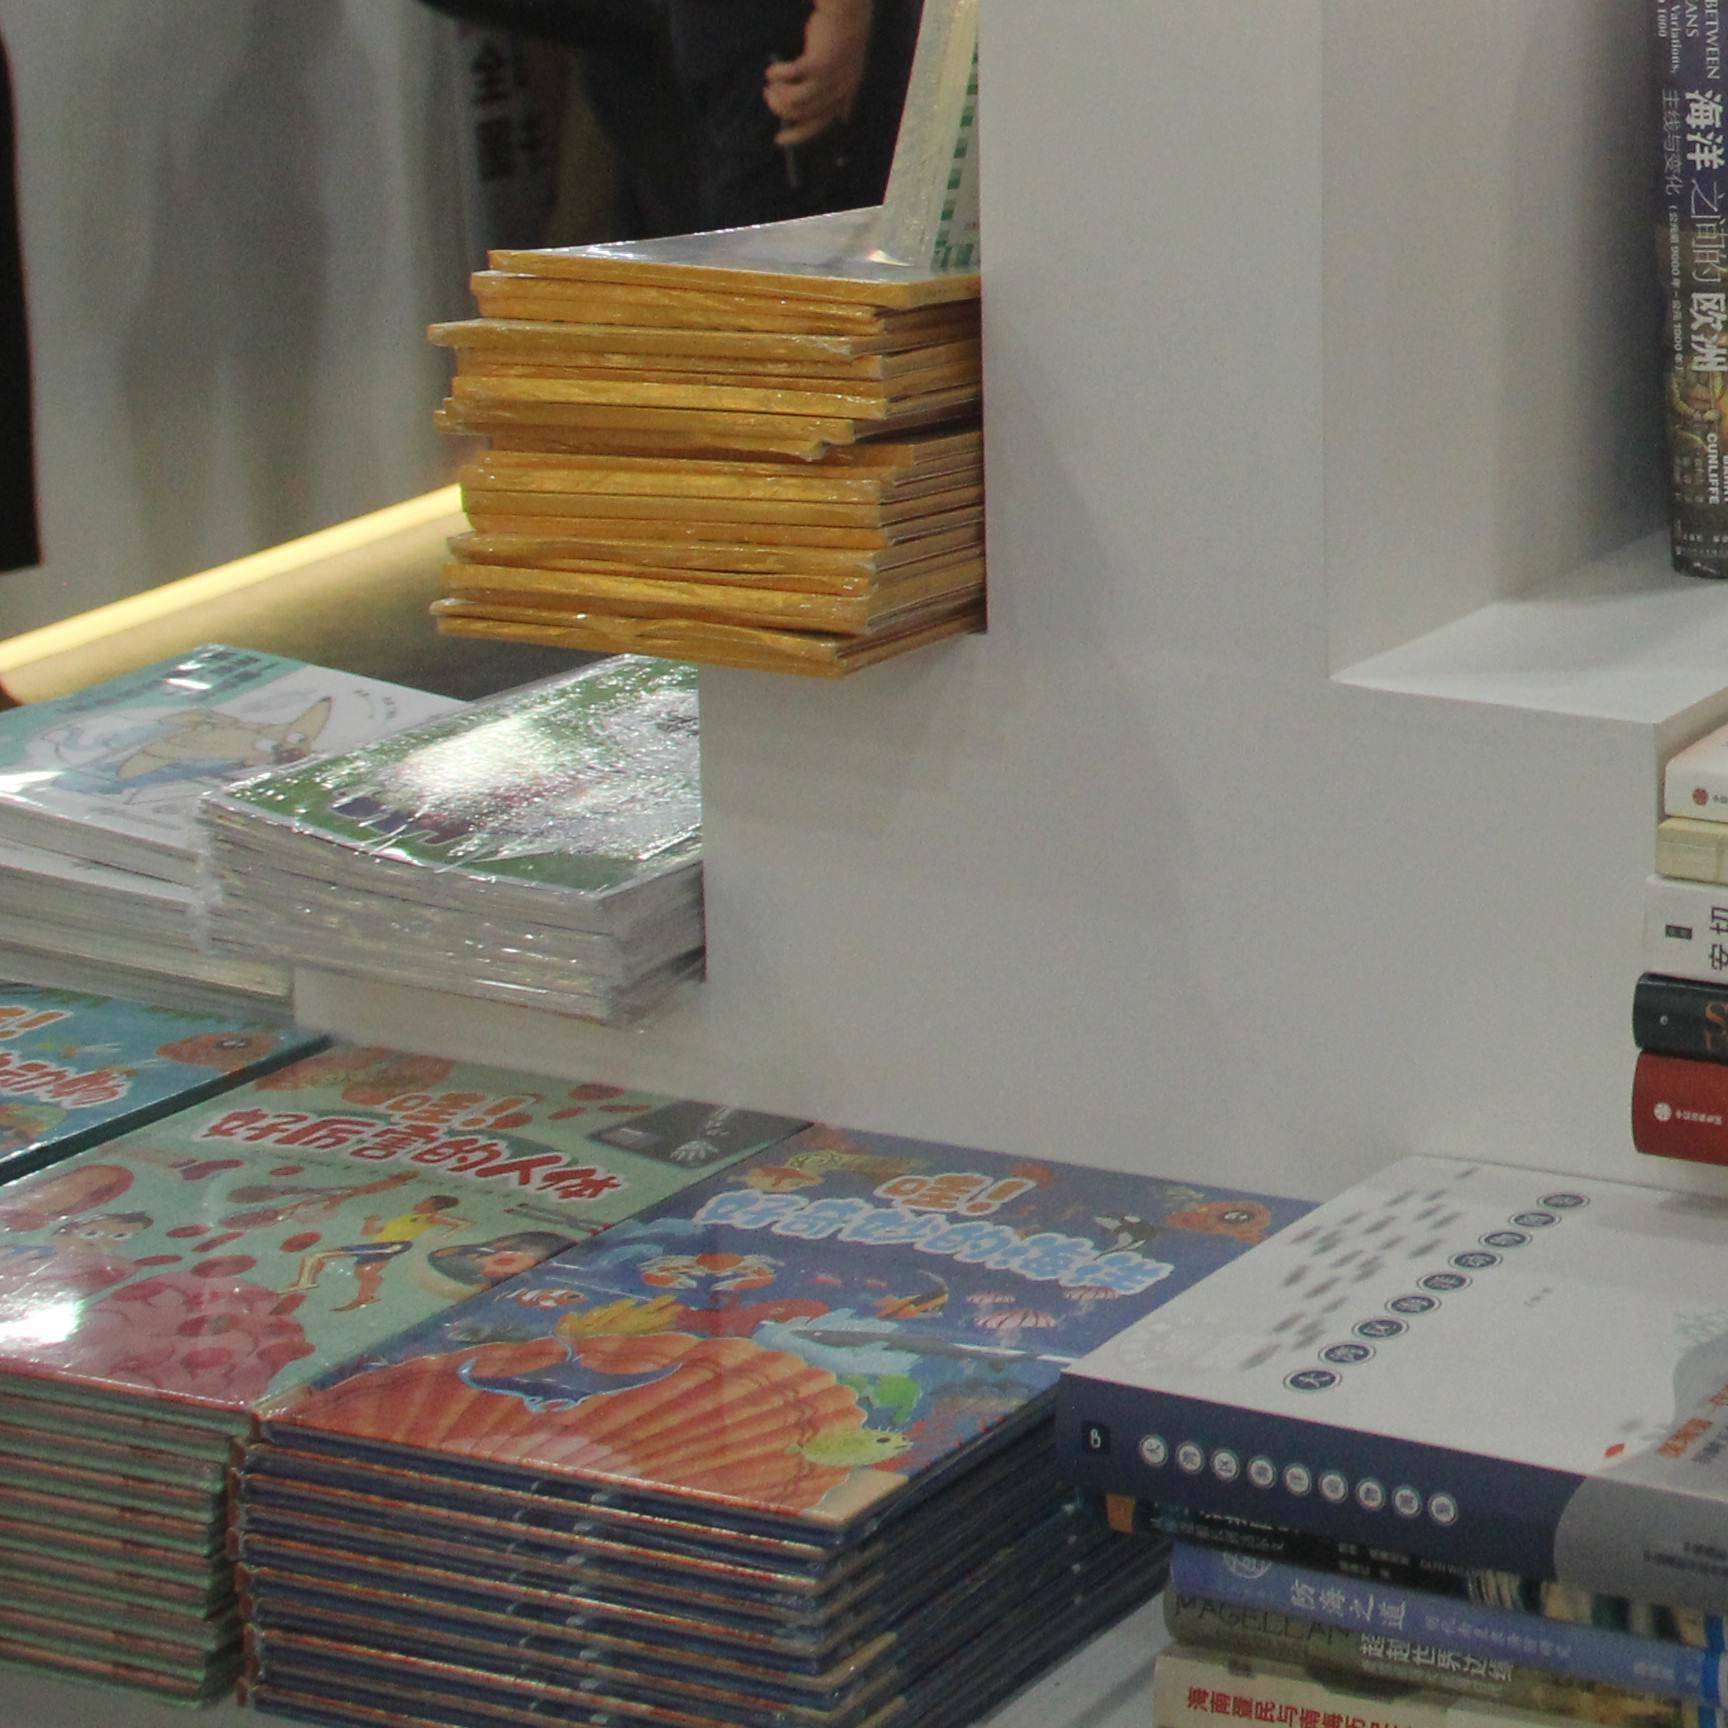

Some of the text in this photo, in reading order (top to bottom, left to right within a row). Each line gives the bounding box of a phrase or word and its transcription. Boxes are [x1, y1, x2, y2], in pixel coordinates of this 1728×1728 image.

[1661, 88, 1682, 196] 主线与变化
[1708, 432, 1720, 505] CUNLIFFE
[200, 1104, 628, 1202] 好厉害的人体
[1175, 1593, 1350, 1645] MAGELLAN
